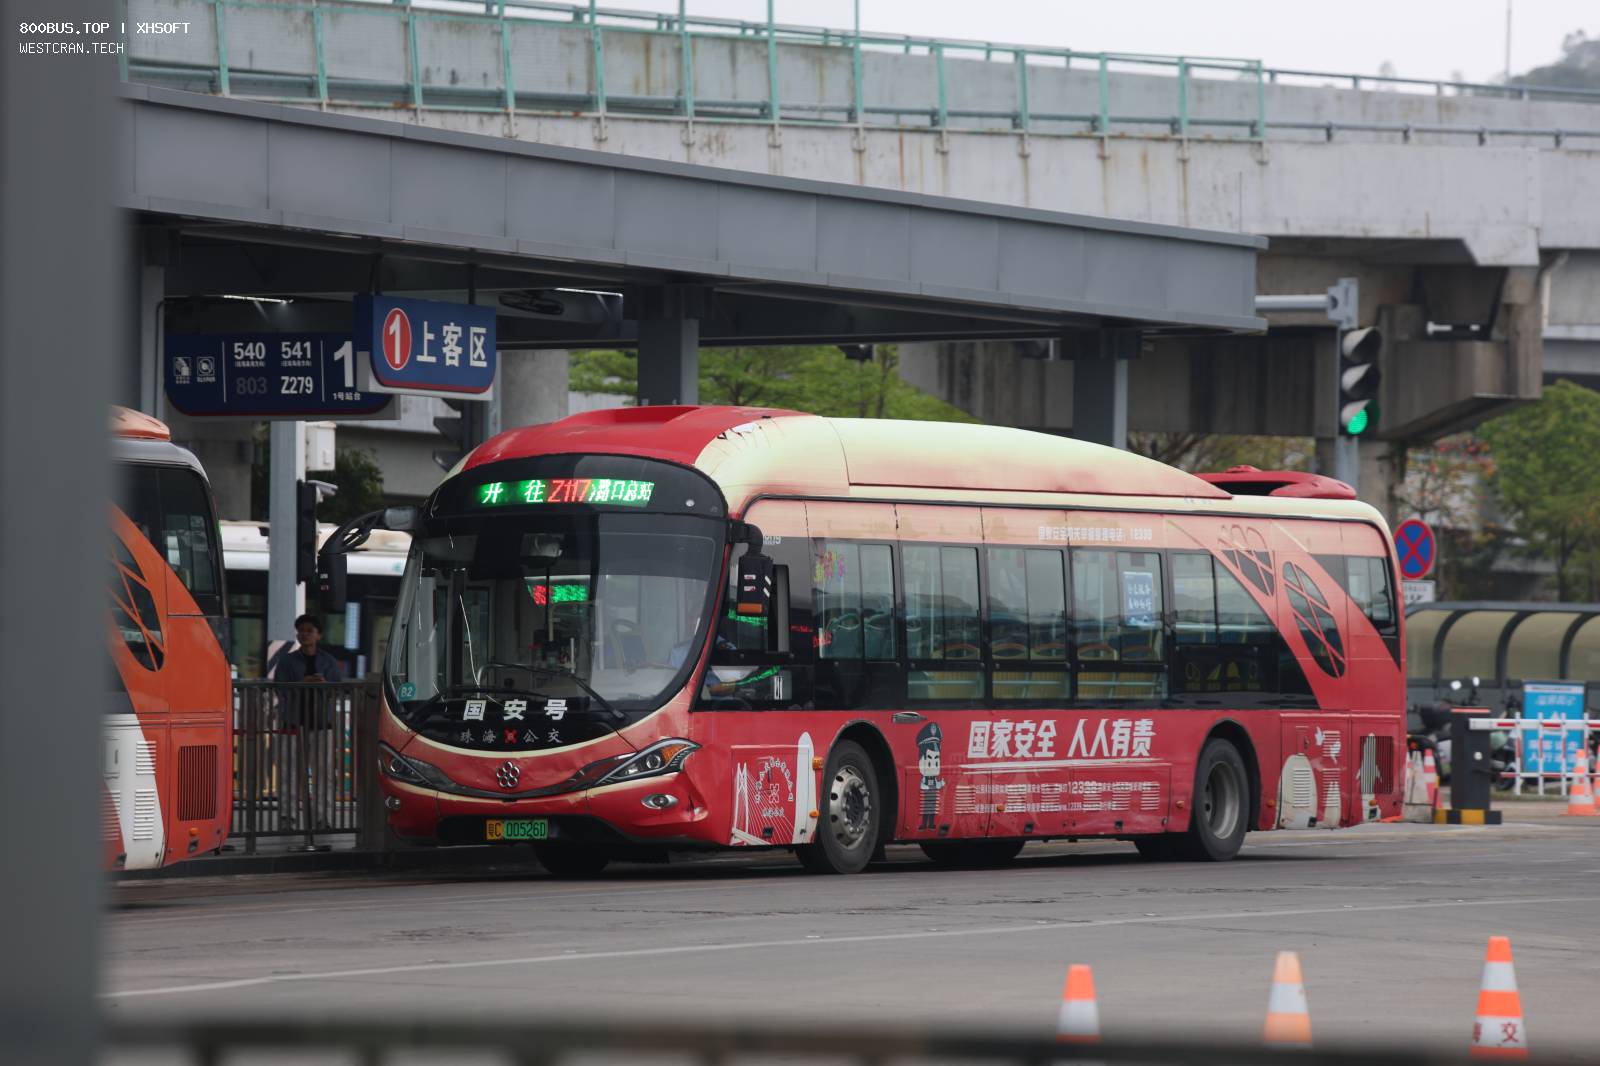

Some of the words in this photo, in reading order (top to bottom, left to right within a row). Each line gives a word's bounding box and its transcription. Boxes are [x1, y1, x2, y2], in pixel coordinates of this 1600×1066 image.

[233, 342, 266, 360] 540
[281, 341, 312, 359] 541
[388, 314, 401, 365] 1
[416, 322, 488, 367] 上客区
[333, 340, 354, 388] 1
[236, 376, 268, 394] 803
[280, 375, 314, 394] Z279
[333, 391, 361, 401] 1号站台
[463, 699, 568, 721] 国安号
[967, 719, 1057, 758] 国家安全
[1067, 719, 1157, 757] 人人有责
